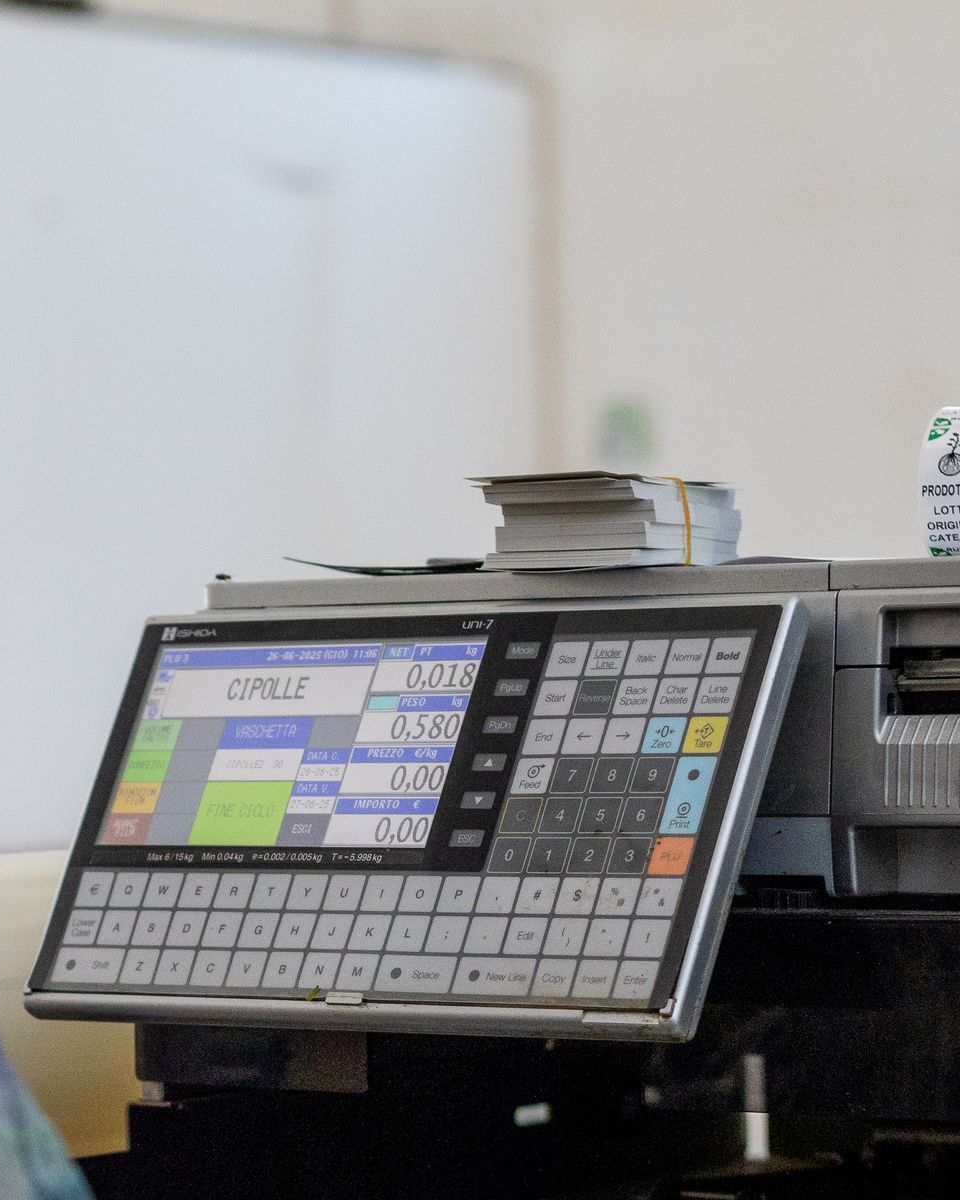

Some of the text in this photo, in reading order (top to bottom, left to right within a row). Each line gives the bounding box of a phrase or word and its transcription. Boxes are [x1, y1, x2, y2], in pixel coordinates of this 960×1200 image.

[927, 521, 960, 531] ORIGI
[389, 645, 478, 657] NET PT kg
[595, 648, 622, 657] Under
[716, 652, 740, 660] Bold
[558, 655, 576, 664] Size
[636, 654, 656, 662] Italic
[673, 653, 702, 661] Normal
[595, 659, 615, 668] Line
[406, 662, 477, 691] 0,018
[227, 676, 310, 701] CIPOLLE
[500, 683, 523, 693] PgUp
[625, 686, 647, 695] Back
[666, 685, 688, 694] Char
[709, 685, 728, 693] Line
[400, 696, 464, 708] PESO kg
[545, 694, 566, 702] Start
[579, 693, 612, 703] Reverse
[618, 696, 648, 707] Space
[659, 695, 689, 705] Delete
[700, 694, 730, 705] Delete
[390, 713, 461, 742] 0,580
[489, 720, 512, 731] PgDn
[234, 724, 297, 739] VASCHETTA
[535, 733, 553, 741] End
[651, 740, 672, 749] Zero
[693, 740, 713, 748] Tare
[367, 748, 439, 760] PREZZO €/kg
[390, 765, 446, 793] 0,00
[568, 770, 577, 781] 7
[607, 769, 616, 781] 8
[648, 769, 657, 781] 9
[519, 780, 541, 788] Feed
[353, 799, 400, 810] IMPORTO
[515, 810, 526, 821] C
[556, 810, 564, 821] 4
[596, 809, 605, 821] 5
[637, 809, 646, 821] 6
[291, 823, 313, 834] ESCI
[374, 816, 430, 844] 0,00
[668, 820, 691, 830] Print
[457, 835, 476, 843] ESC
[146, 852, 163, 861] Max
[201, 852, 216, 861] Min
[505, 849, 513, 861] 0
[546, 850, 551, 860] 1
[584, 849, 594, 861] 2
[625, 850, 634, 862] 3
[125, 885, 133, 895] Q
[159, 886, 169, 894] W
[195, 886, 203, 895] E
[230, 886, 238, 896] R
[268, 887, 275, 896] T
[305, 888, 311, 897] Y
[340, 888, 349, 898] U
[415, 889, 424, 899] O
[454, 890, 463, 899] P
[534, 890, 541, 900] #
[573, 889, 582, 901] $
[113, 923, 119, 932] A
[147, 923, 155, 933] S
[182, 923, 191, 933] D
[218, 924, 226, 933] F
[254, 925, 263, 935] G
[290, 926, 299, 935] H
[328, 927, 336, 936] J
[365, 928, 374, 936] K
[404, 929, 410, 938] L
[517, 931, 534, 940] Edit
[135, 961, 144, 971] Z
[171, 963, 179, 971] X
[206, 963, 215, 973] C
[244, 964, 251, 974] V
[278, 965, 287, 974] B
[315, 966, 324, 975] N
[352, 967, 363, 976] M
[411, 970, 440, 981] Space
[485, 972, 527, 983] New Line
[541, 974, 566, 985] Copy
[581, 974, 608, 985] Insert
[622, 975, 649, 985] Enter
